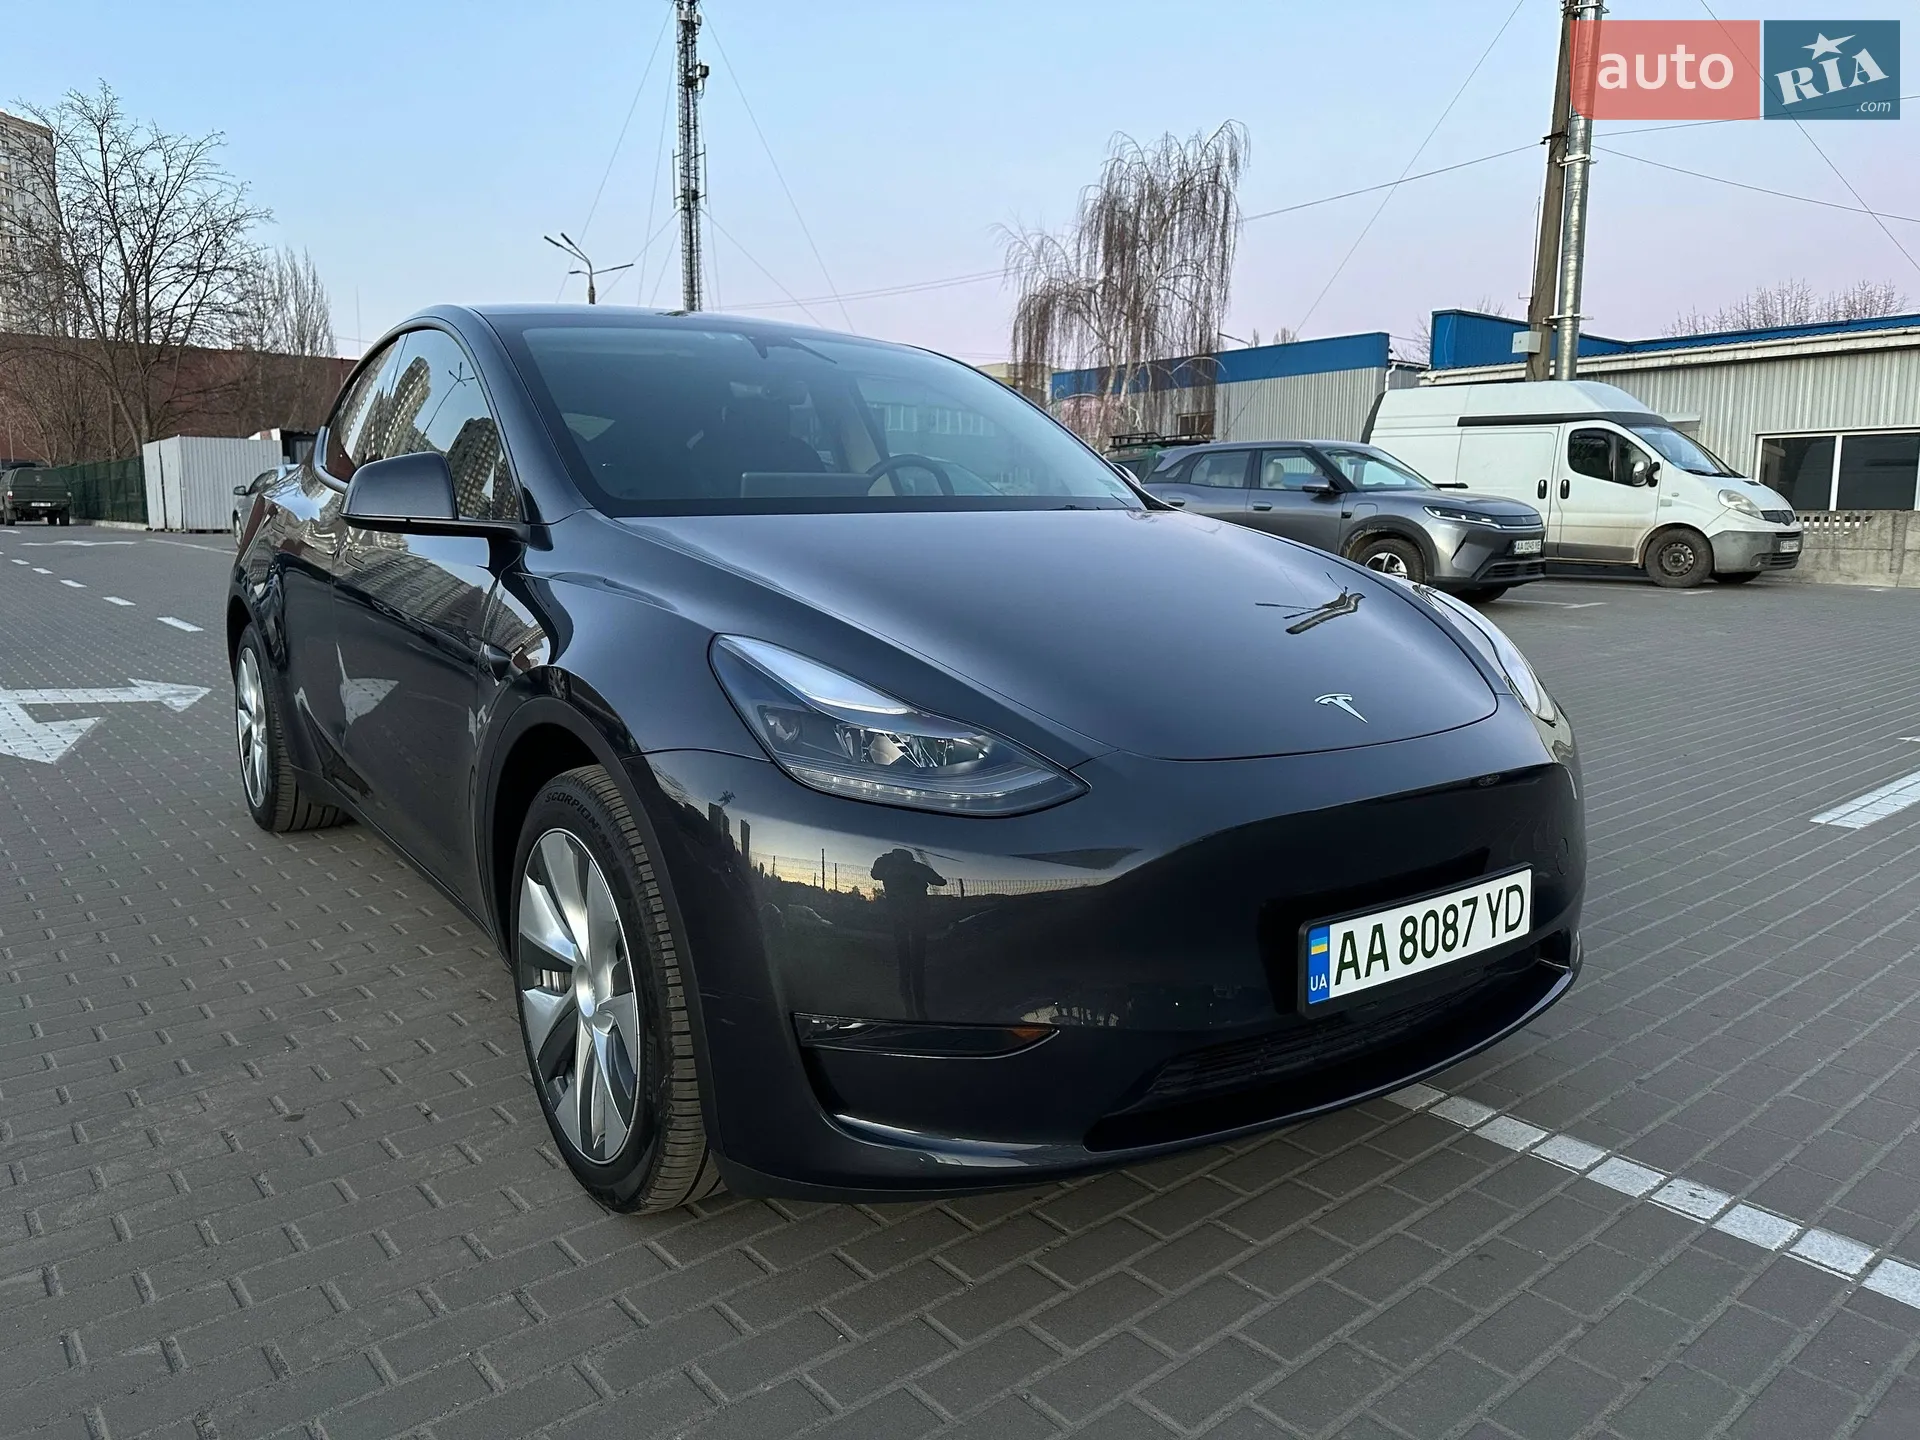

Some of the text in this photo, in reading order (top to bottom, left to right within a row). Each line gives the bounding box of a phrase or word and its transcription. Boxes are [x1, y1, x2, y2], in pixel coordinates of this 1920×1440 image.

[545, 791, 600, 830] SCORPION
[1334, 884, 1525, 985] AA 8087 YD
[1310, 973, 1328, 991] UA
